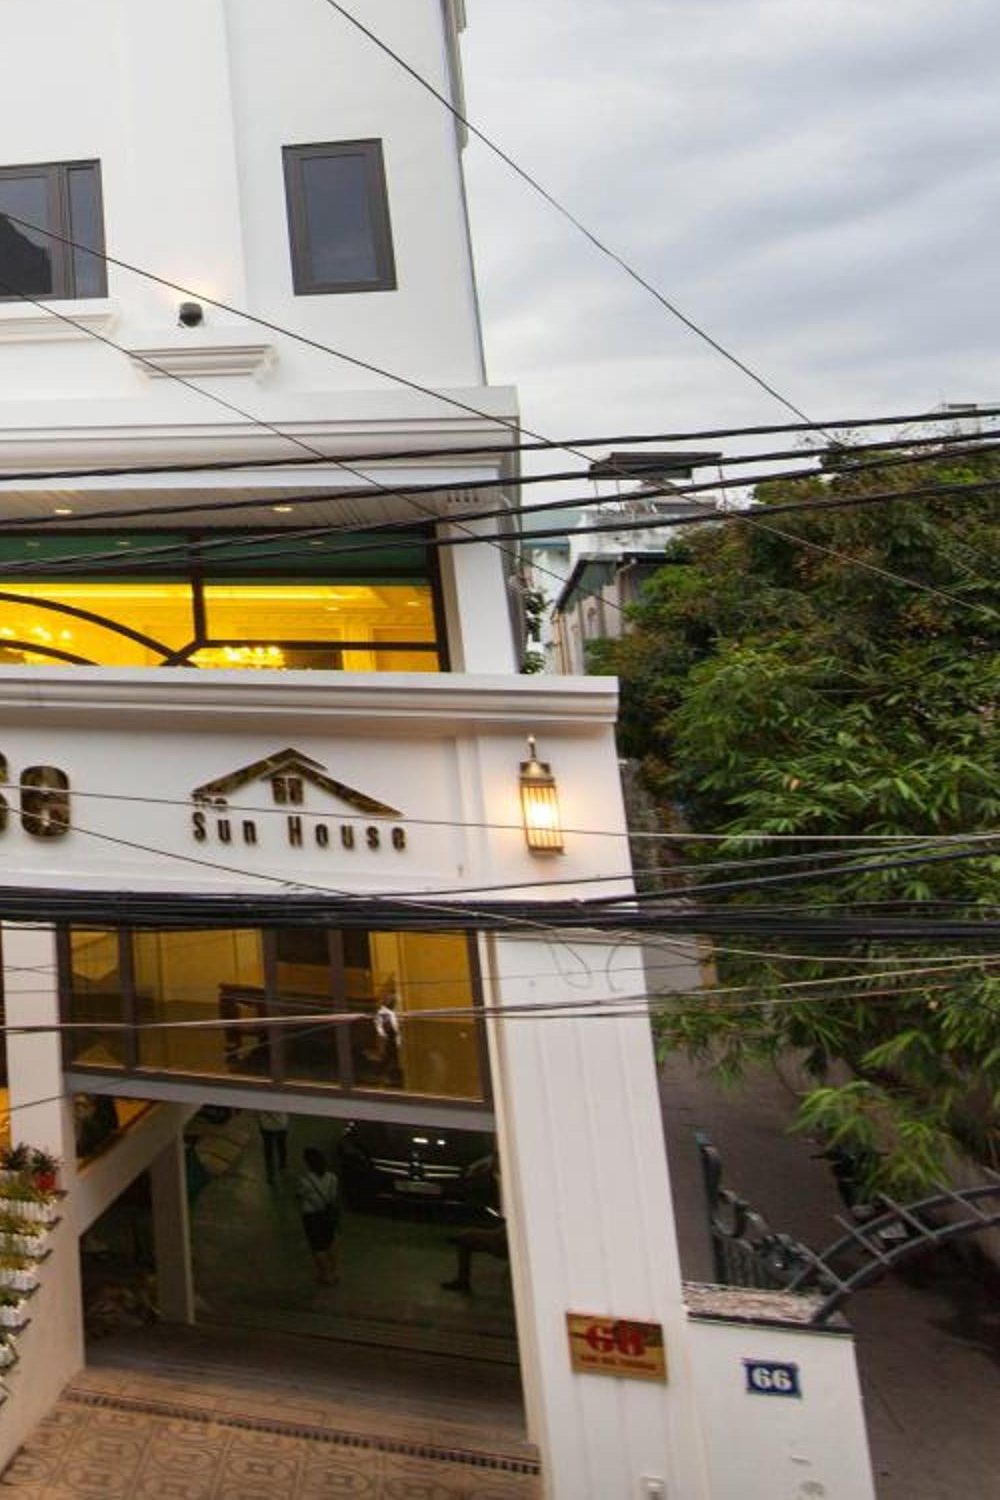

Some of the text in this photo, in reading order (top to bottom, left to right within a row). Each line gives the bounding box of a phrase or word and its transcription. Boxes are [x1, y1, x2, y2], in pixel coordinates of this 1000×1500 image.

[192, 812, 406, 851] Sun House
[752, 1367, 792, 1390] 66
